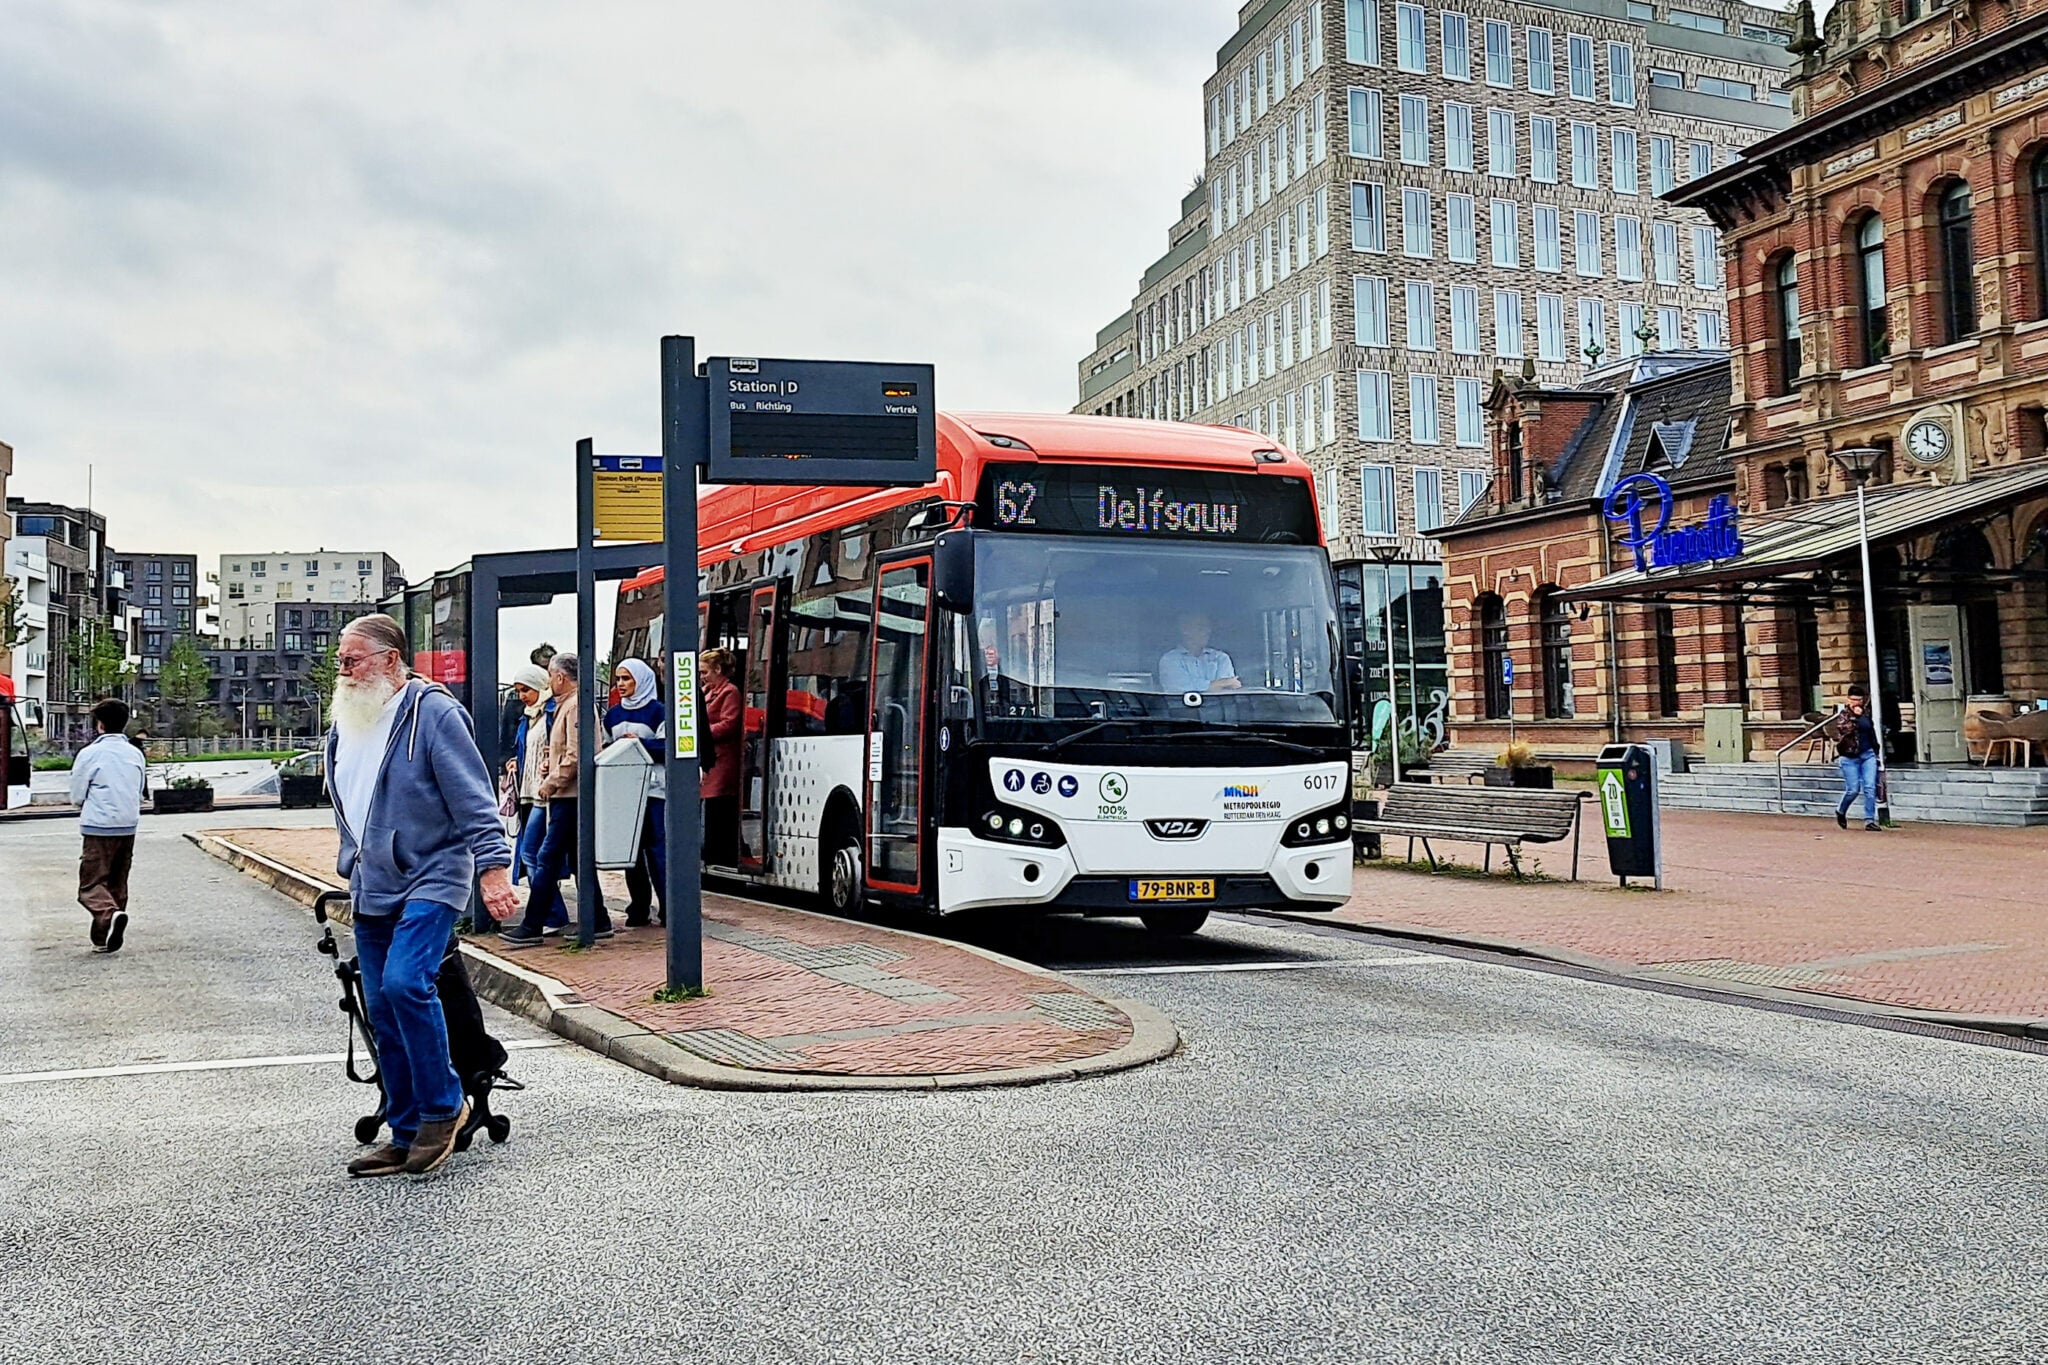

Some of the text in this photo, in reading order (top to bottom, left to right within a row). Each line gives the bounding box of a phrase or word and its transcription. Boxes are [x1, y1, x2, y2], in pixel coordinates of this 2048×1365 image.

[729, 380, 777, 393] Station
[787, 381, 798, 393] D
[729, 401, 792, 413] Bus Richting
[885, 404, 918, 414] Vertrek
[999, 481, 1239, 534] 62 Delfgauw
[1303, 775, 1338, 790] 6017
[1224, 784, 1259, 798] MRDH
[1097, 805, 1128, 815] 100%
[1223, 801, 1281, 810] METROPOOLREGIO
[1154, 821, 1198, 835] VDL
[1141, 881, 1210, 897] 79-BNR-8
